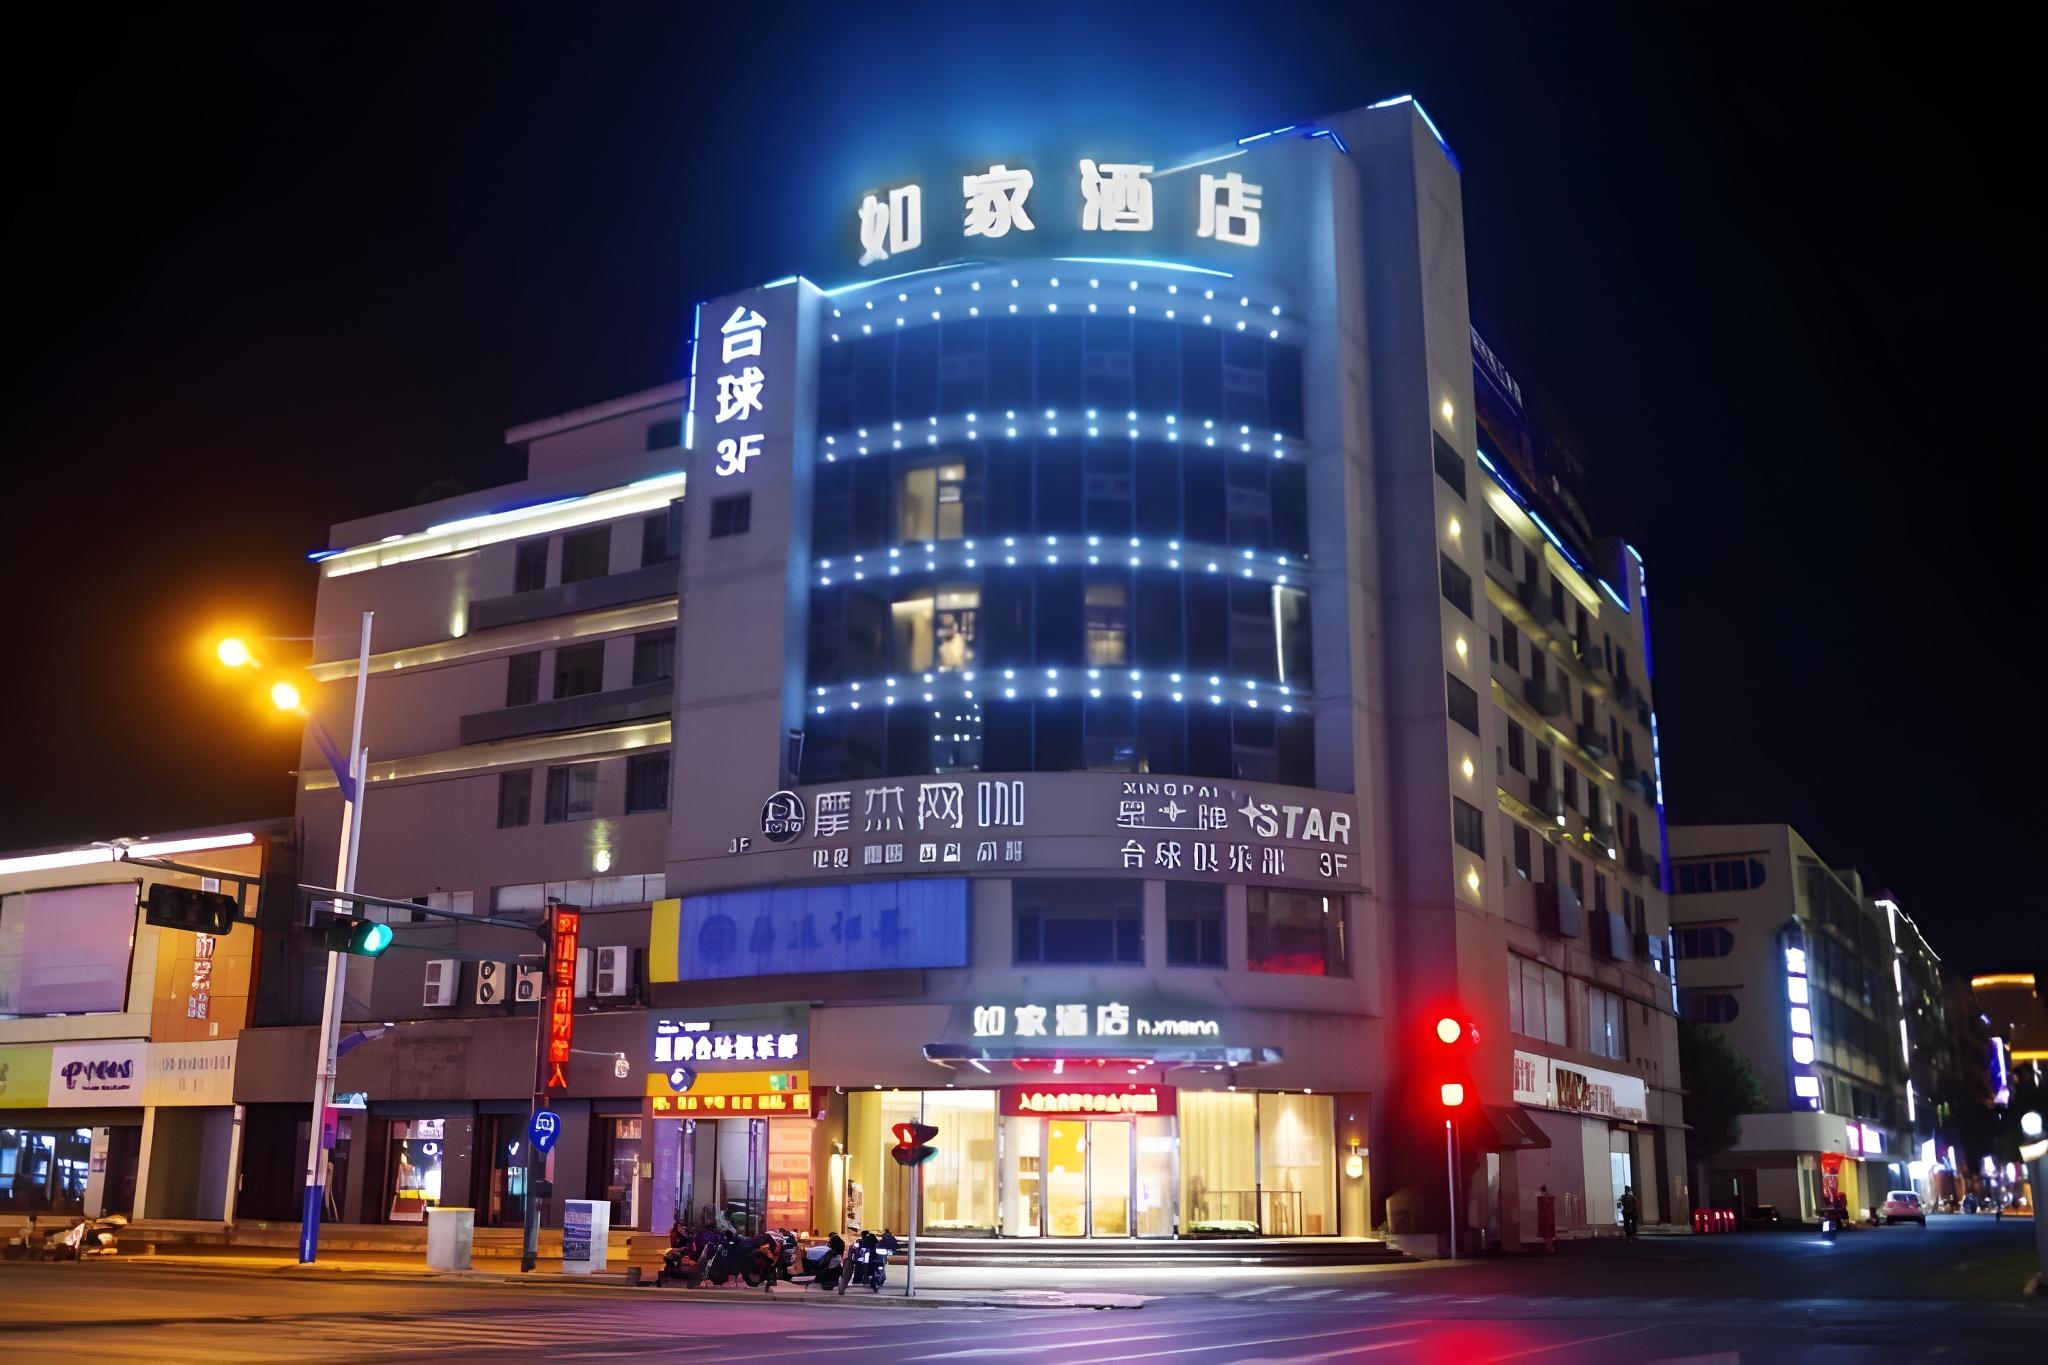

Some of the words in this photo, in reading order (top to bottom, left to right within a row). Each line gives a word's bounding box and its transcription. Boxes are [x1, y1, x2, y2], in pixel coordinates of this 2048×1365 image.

[858, 158, 1263, 267] 如家酒店
[715, 306, 768, 424] 台球
[715, 433, 765, 477] 3F
[1256, 803, 1351, 845] STAR
[1319, 852, 1348, 877] 3F
[973, 1002, 1130, 1037] 如家酒店
